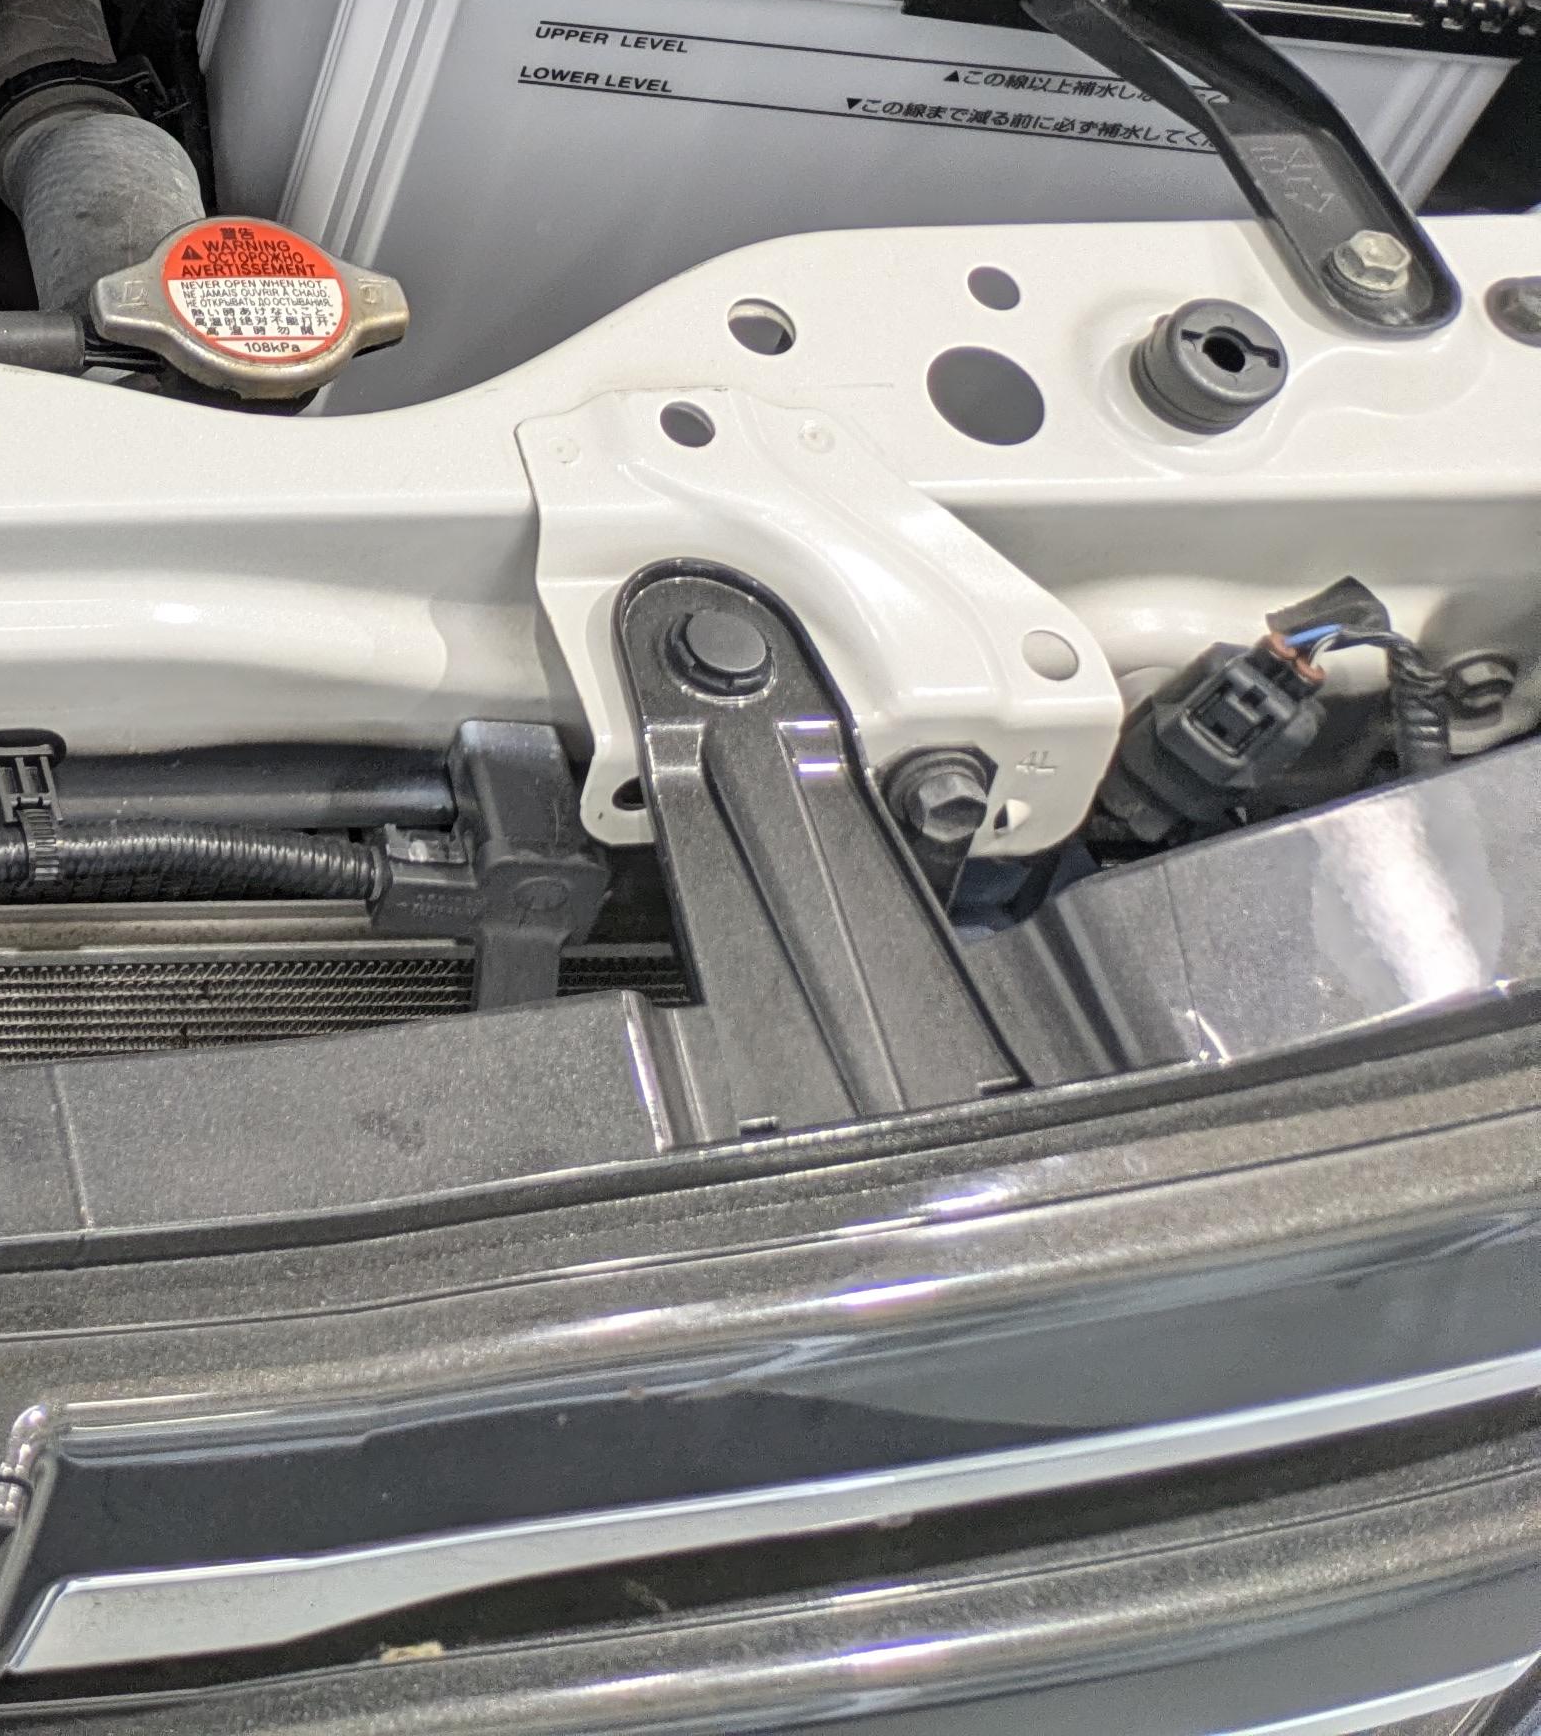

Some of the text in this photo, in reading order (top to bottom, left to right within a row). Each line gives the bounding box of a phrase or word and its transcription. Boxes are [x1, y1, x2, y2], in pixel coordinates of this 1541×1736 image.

[535, 26, 689, 53] UPPER LEVEL
[520, 65, 673, 93] LOWER LEVEL
[203, 239, 291, 254] WARNING
[207, 251, 304, 265] ОСТОРОЖНО
[181, 263, 316, 278] AVERTISSEMENT
[181, 280, 327, 290] NEVER OPEN WHEN HOT.
[184, 290, 197, 298] NE
[200, 289, 238, 299] JAMAIS
[241, 289, 280, 298] OUVRIR
[292, 289, 330, 299] CHAUD.
[186, 299, 198, 307] НЕ
[200, 298, 255, 307] ОТКРЫВАТЬ
[258, 298, 272, 308] ДО
[244, 341, 301, 354] 108kPa
